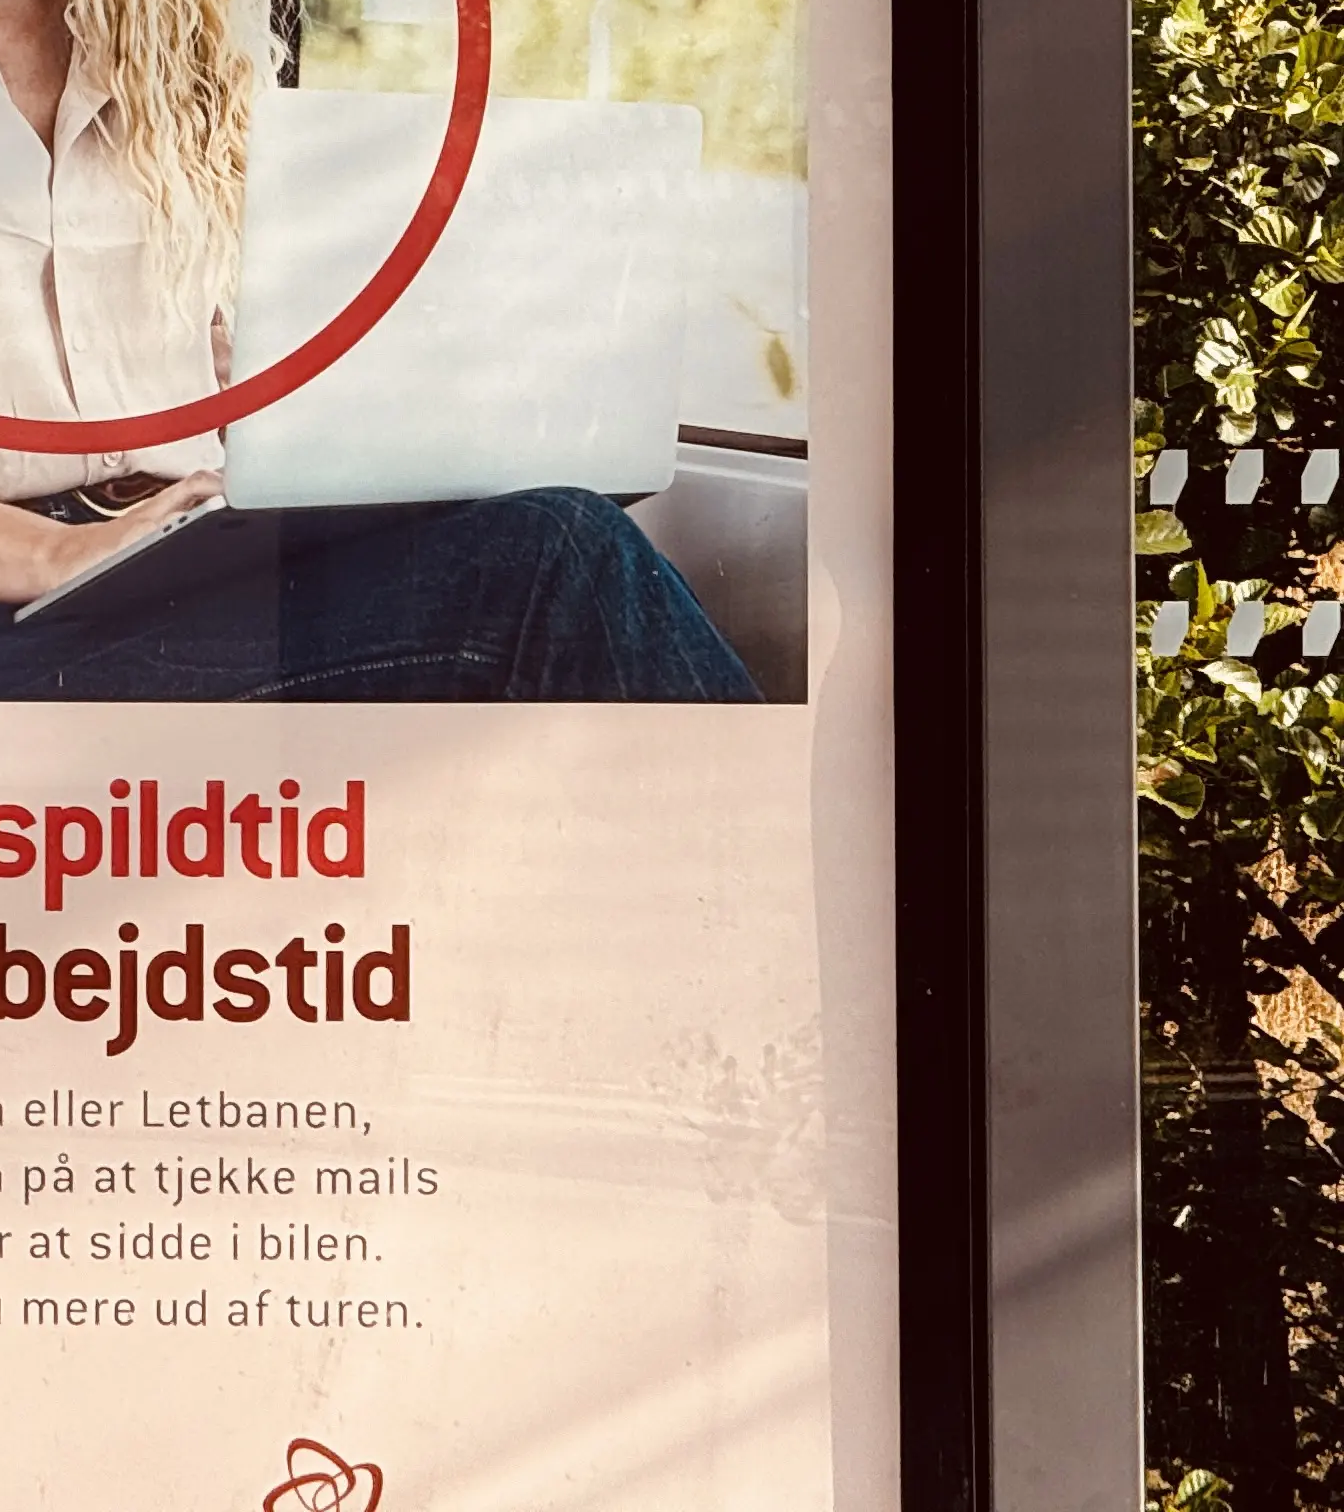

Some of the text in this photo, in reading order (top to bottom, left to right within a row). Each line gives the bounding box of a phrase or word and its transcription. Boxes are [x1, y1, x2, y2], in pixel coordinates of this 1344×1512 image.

[25, 1090, 123, 1127] eller
[144, 1090, 370, 1136] Letbanen,
[25, 1153, 73, 1205] på
[96, 1162, 135, 1193] at
[155, 1156, 294, 1206] tjekke
[317, 1157, 437, 1195] mails
[30, 1228, 70, 1259] at
[91, 1222, 211, 1260] sidde
[232, 1223, 239, 1260] i
[261, 1224, 381, 1261] bilen.
[24, 1299, 135, 1326] mere
[157, 1290, 206, 1326] ud
[228, 1289, 271, 1326] af
[286, 1296, 422, 1328] turen.
